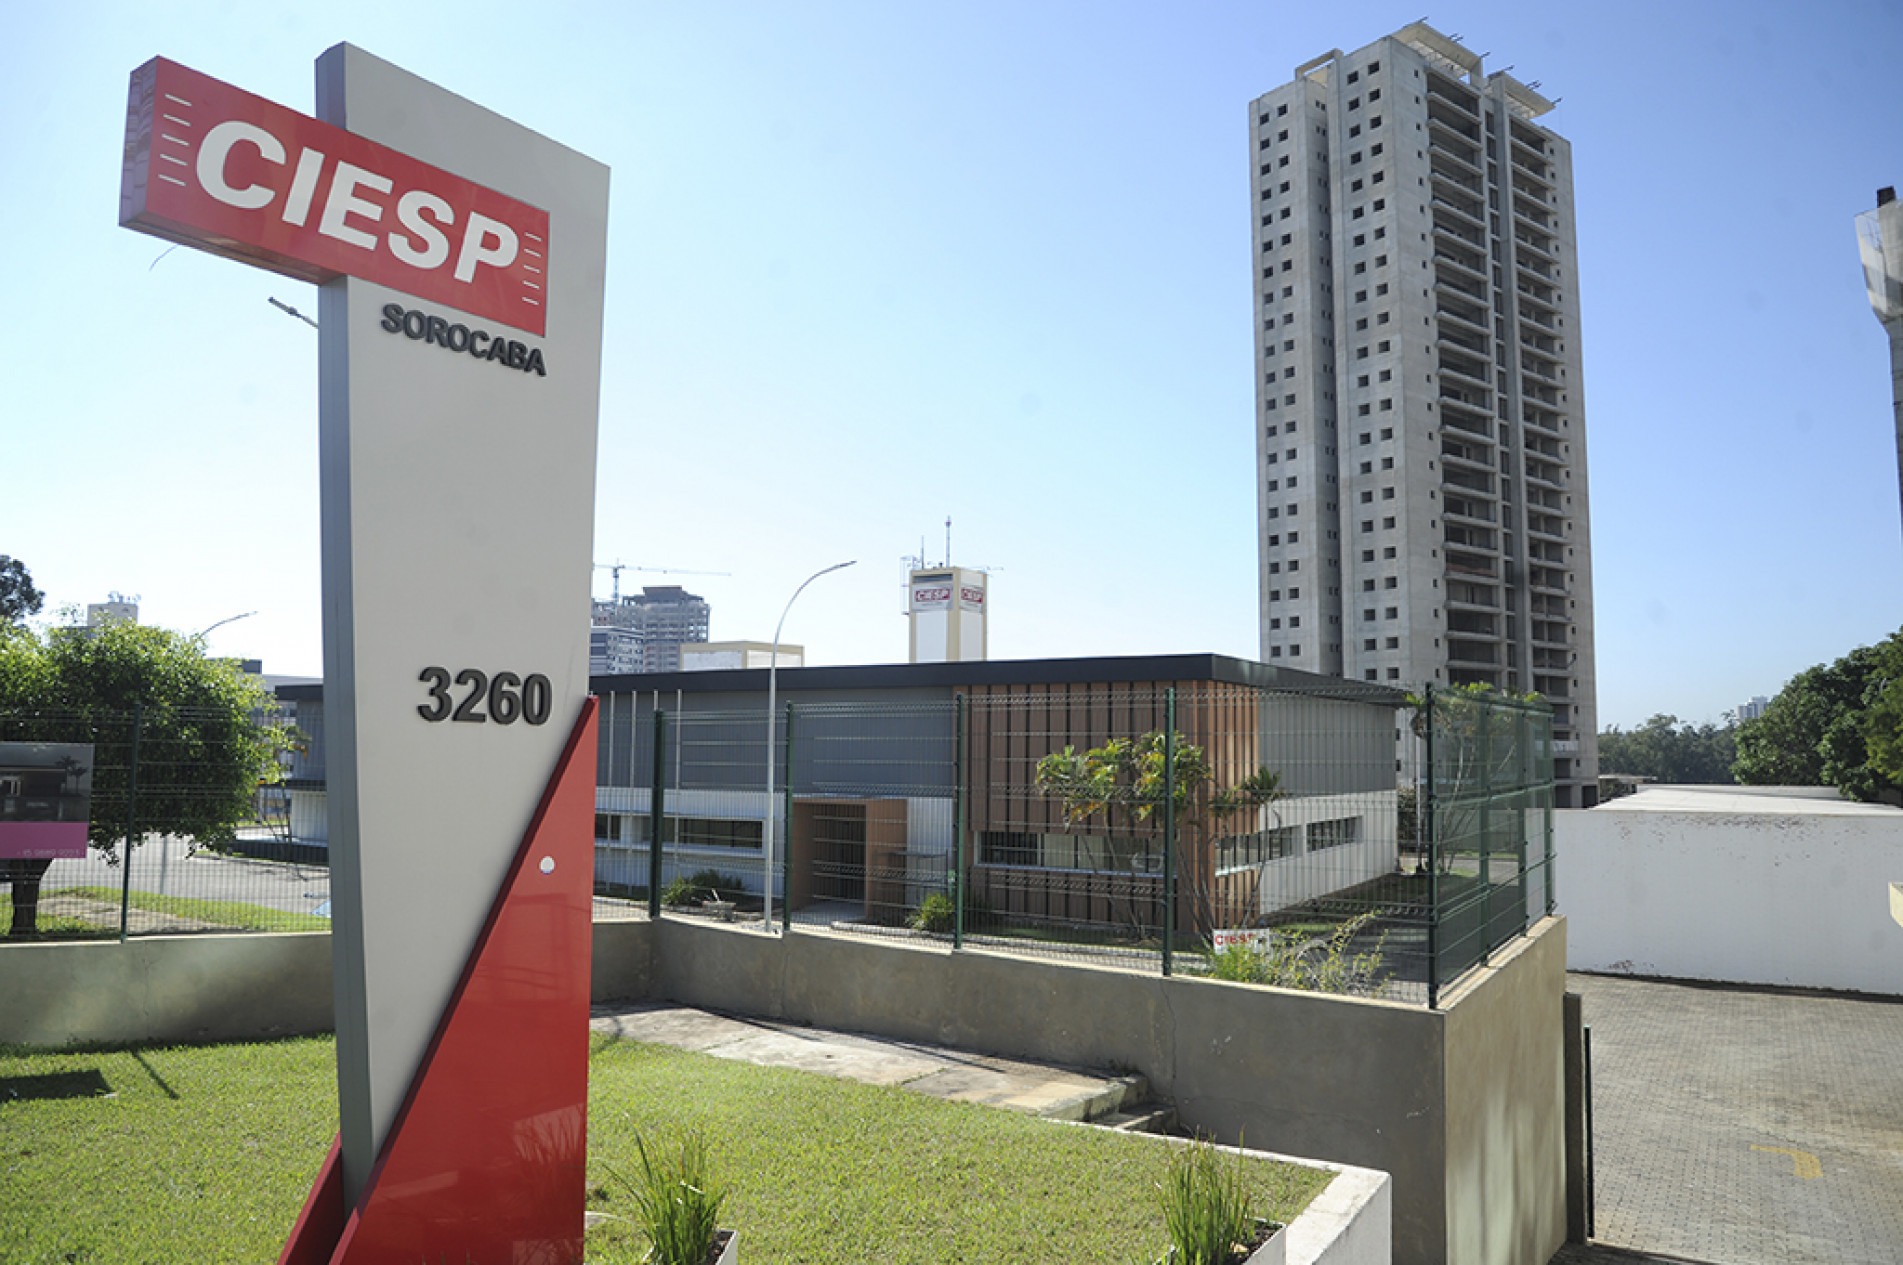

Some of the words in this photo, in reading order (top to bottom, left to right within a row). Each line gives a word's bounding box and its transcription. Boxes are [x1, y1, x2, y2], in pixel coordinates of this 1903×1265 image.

[196, 120, 519, 283] CIESP
[381, 303, 546, 376] SOROCABA
[417, 666, 552, 725] 3260
